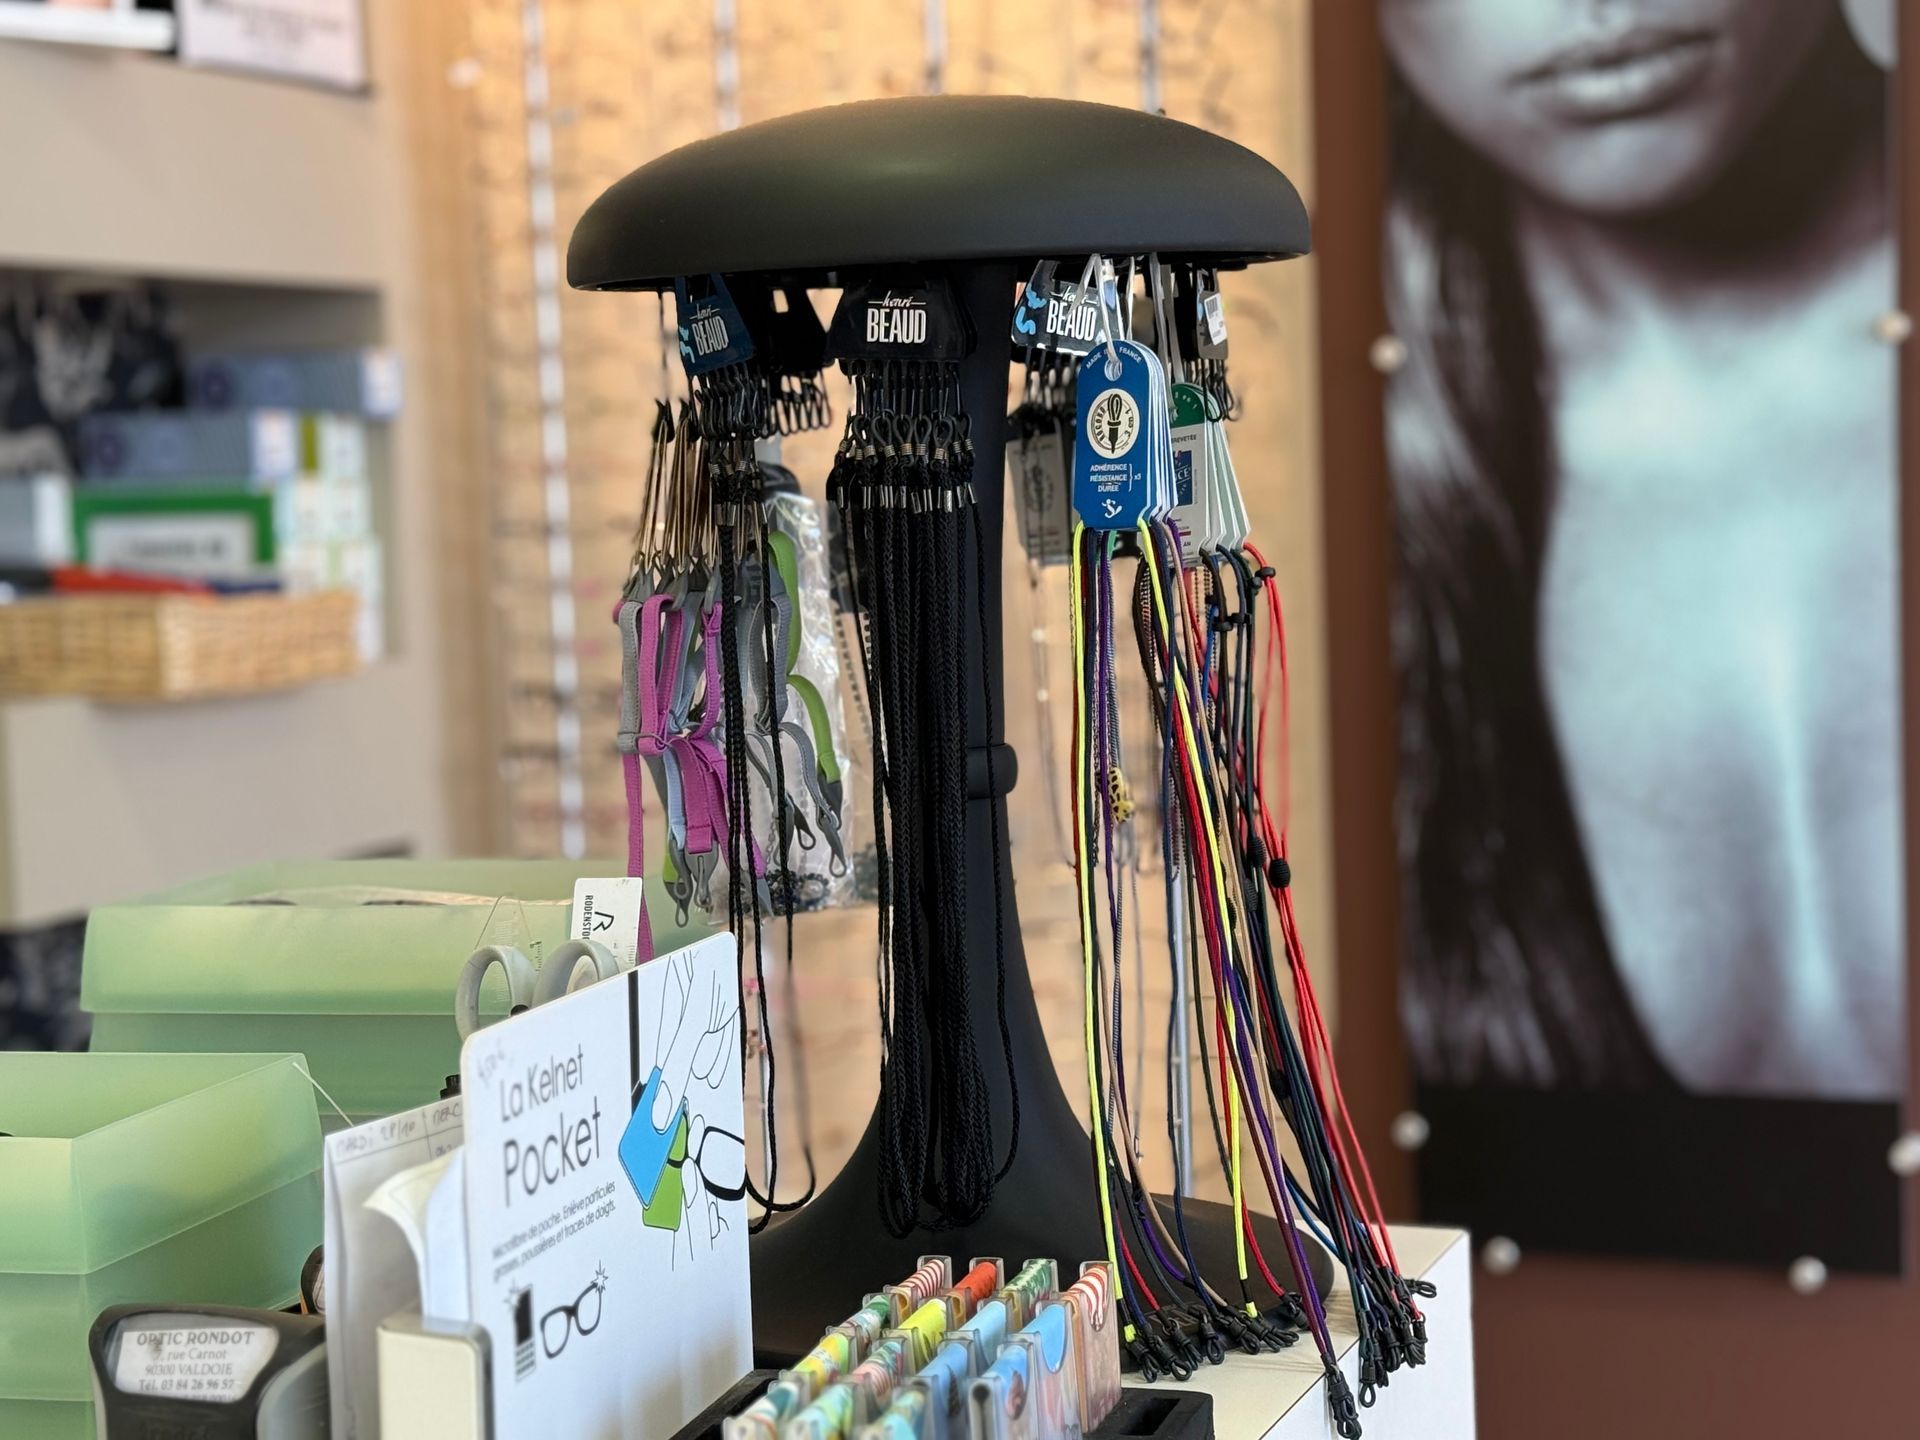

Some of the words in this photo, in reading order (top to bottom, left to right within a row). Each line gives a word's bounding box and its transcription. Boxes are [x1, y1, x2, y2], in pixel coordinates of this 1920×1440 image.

[882, 290, 912, 308] henri
[695, 303, 712, 318] henri
[1046, 298, 1097, 341] BEAUD
[691, 315, 729, 356] BEAUD
[866, 308, 927, 344] BEAUD
[1086, 353, 1102, 369] MADE
[1119, 346, 1142, 364] FRANCE
[1089, 463, 1128, 472] ADHÉRENCE
[1089, 473, 1128, 482] RÉSISTANCE
[500, 1079, 524, 1123] La
[527, 1043, 584, 1110] Kelnet
[503, 1095, 601, 1208] Pocket
[563, 1200, 585, 1220] Enlève
[585, 1181, 616, 1210] particules
[556, 1227, 564, 1243] et
[564, 1218, 585, 1239] traces
[585, 1211, 595, 1226] de
[595, 1199, 616, 1220] doigts.
[136, 1331, 184, 1346] OPTIC
[185, 1331, 256, 1346] RONDOT
[167, 1350, 186, 1361] rue
[188, 1347, 227, 1361] Carnot
[144, 1363, 176, 1377] 90300
[178, 1362, 233, 1376] VALDOIE
[161, 1379, 173, 1391] 03
[176, 1379, 188, 1390] 84
[191, 1379, 204, 1390] 26
[221, 1379, 235, 1390] 57
